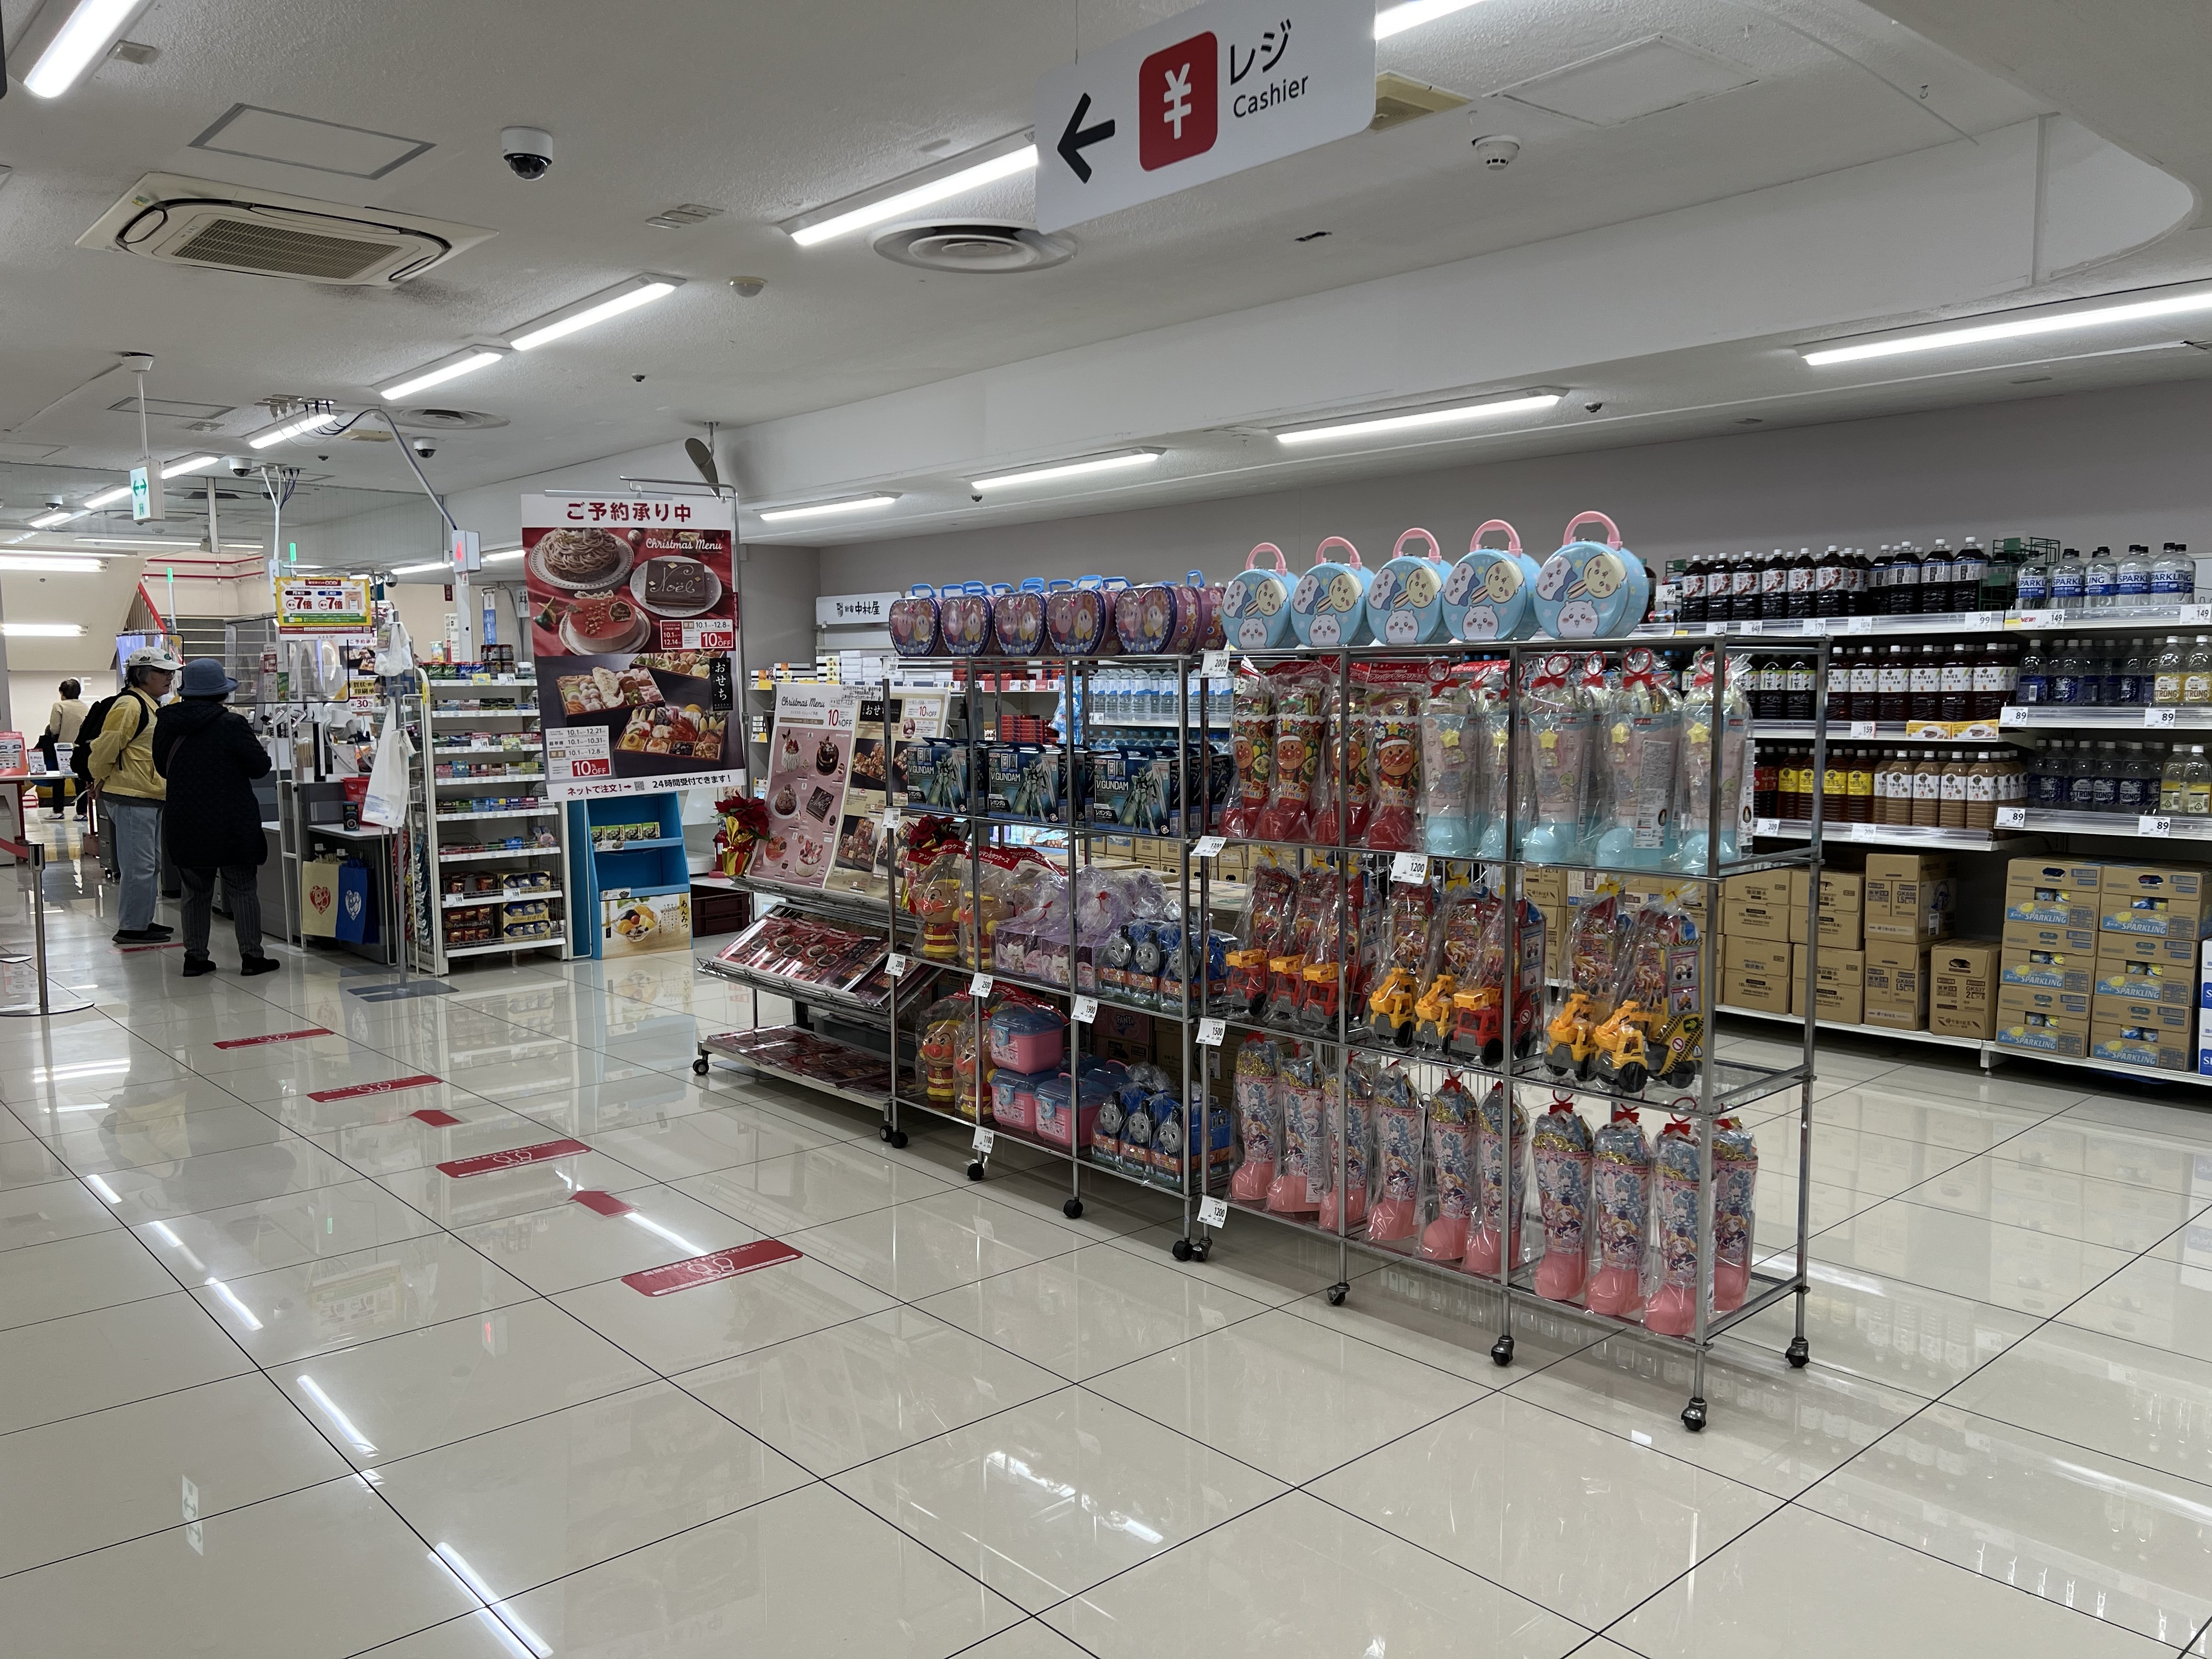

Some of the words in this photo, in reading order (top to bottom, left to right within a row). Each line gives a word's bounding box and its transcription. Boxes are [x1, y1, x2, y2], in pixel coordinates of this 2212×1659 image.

[1229, 19, 1292, 86] レジ
[1233, 76, 1309, 119] Cashier
[566, 501, 691, 522] ご予約承り中
[646, 538, 693, 550] Christmas
[695, 539, 723, 550] Menu
[2051, 614, 2062, 622] 149
[2197, 610, 2209, 618] 149
[1215, 659, 1227, 667] 2000
[715, 662, 727, 701] おせち
[781, 696, 808, 707] Christmas
[809, 698, 825, 708] Menu
[865, 704, 884, 716] おせ
[652, 775, 731, 789] 24時間受付できます!
[567, 783, 623, 796] ネットで注文!
[2012, 812, 2024, 821] 89
[2157, 821, 2169, 830] 89
[1410, 862, 1425, 873] 1200
[680, 900, 689, 929] あんみつ
[2024, 912, 2067, 924] SPARKLING
[2121, 922, 2166, 935] SPARKLING
[895, 960, 904, 968] 2000
[2019, 975, 2062, 988] SPARKLING
[2115, 986, 2159, 999] SPARKLING
[1086, 1005, 1096, 1014] 1900
[1212, 1026, 1223, 1036] 1500
[2014, 1037, 2056, 1049] SPARKLING
[2112, 1051, 2157, 1064] SPARKLING
[984, 1135, 992, 1144] 1100
[1214, 1207, 1225, 1217] 1200
